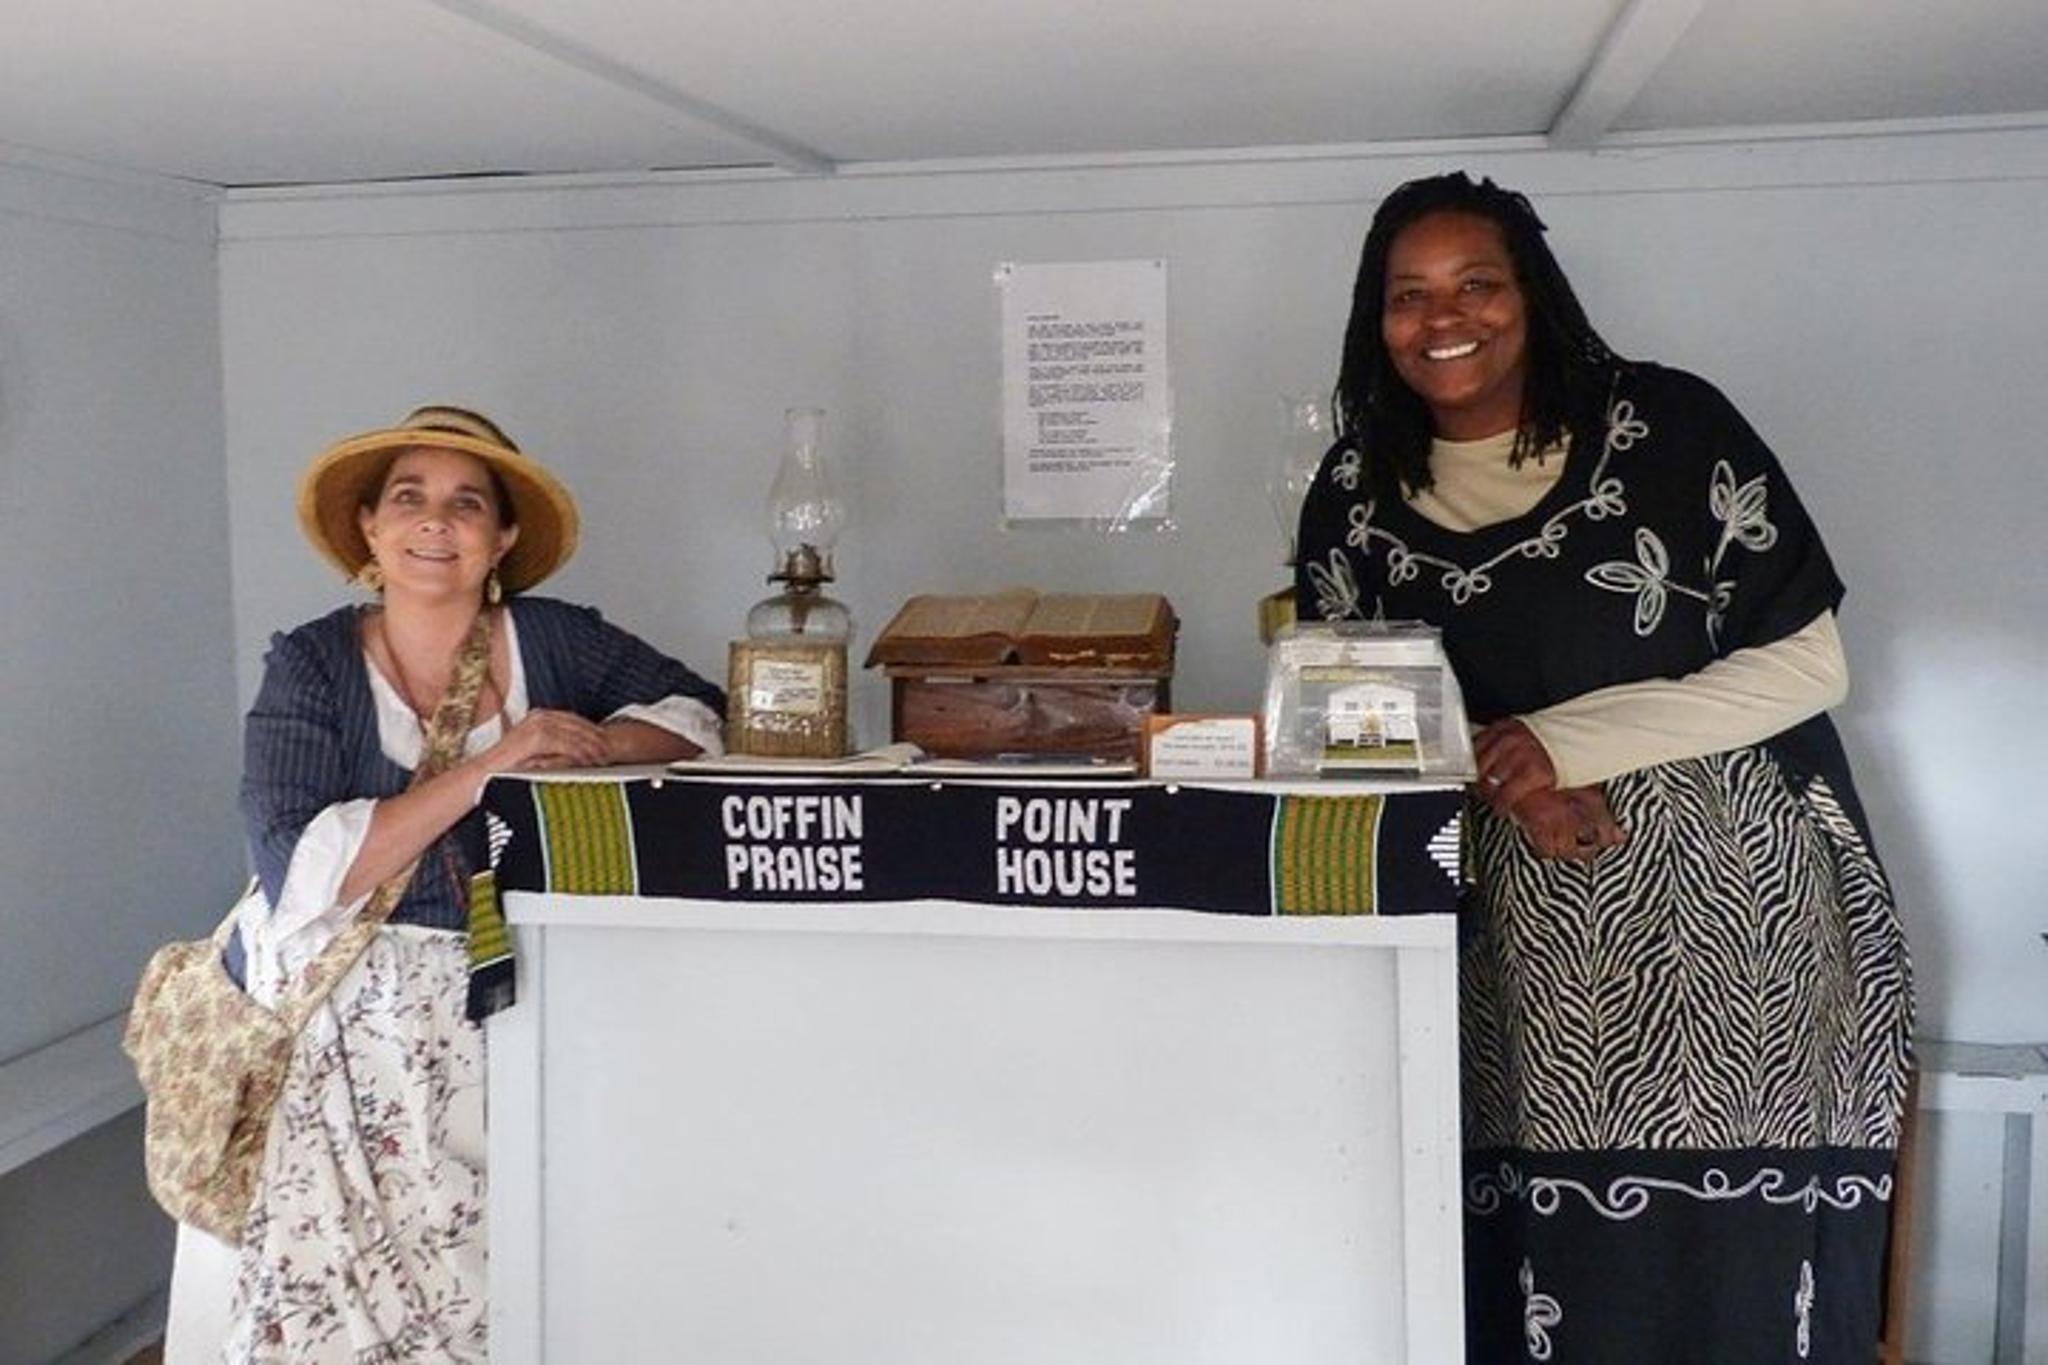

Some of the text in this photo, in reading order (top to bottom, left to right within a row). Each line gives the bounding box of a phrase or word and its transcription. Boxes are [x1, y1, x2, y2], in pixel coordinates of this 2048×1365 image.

[722, 795, 1131, 845] COFFIN POINT
[725, 845, 1137, 898] PRAISE HOUSE
